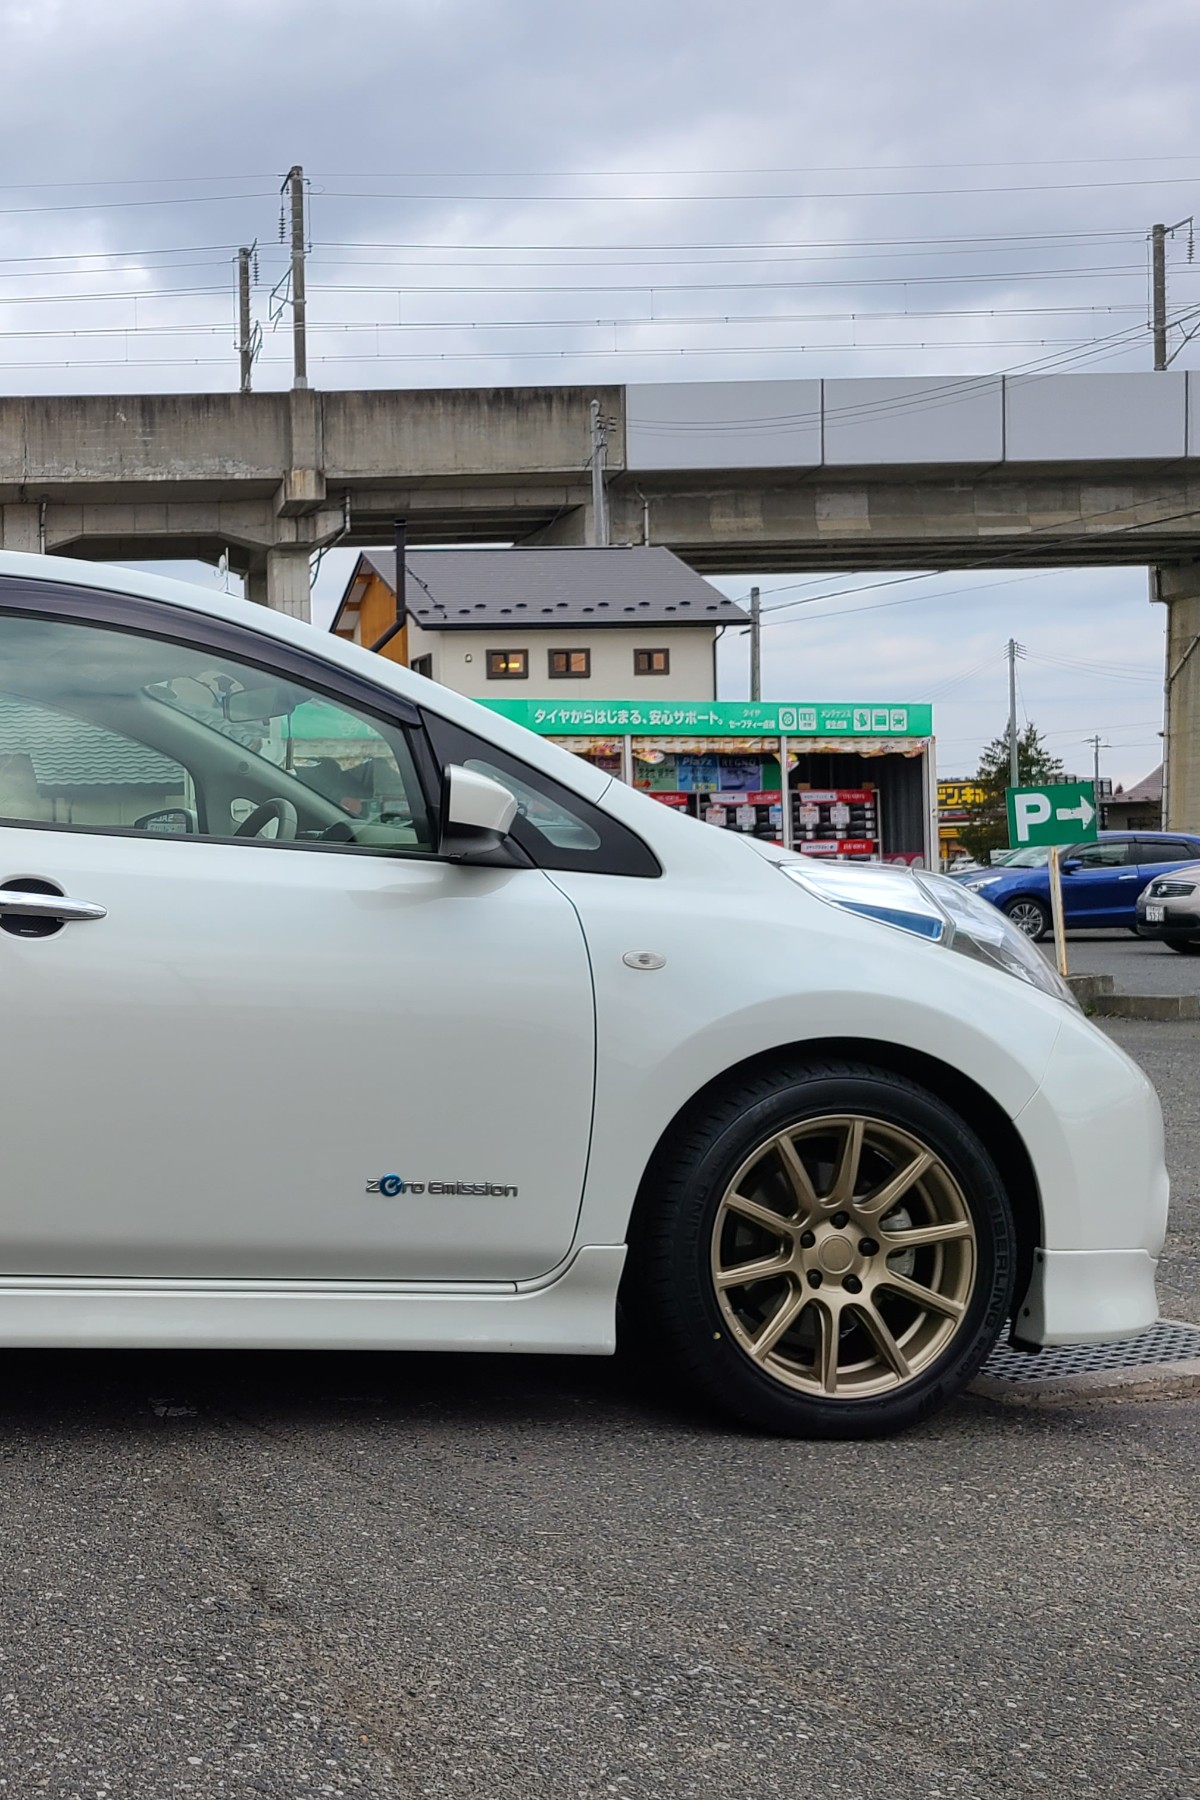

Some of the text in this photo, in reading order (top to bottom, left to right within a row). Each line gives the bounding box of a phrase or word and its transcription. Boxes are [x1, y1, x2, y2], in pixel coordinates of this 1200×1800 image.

[534, 708, 724, 726] タイヤからはじまる、安心サポート。
[742, 709, 761, 718] タイヤ
[1014, 793, 1052, 842] P
[427, 1179, 519, 1198] Emission
[980, 1180, 1009, 1329] SEIBERLING
